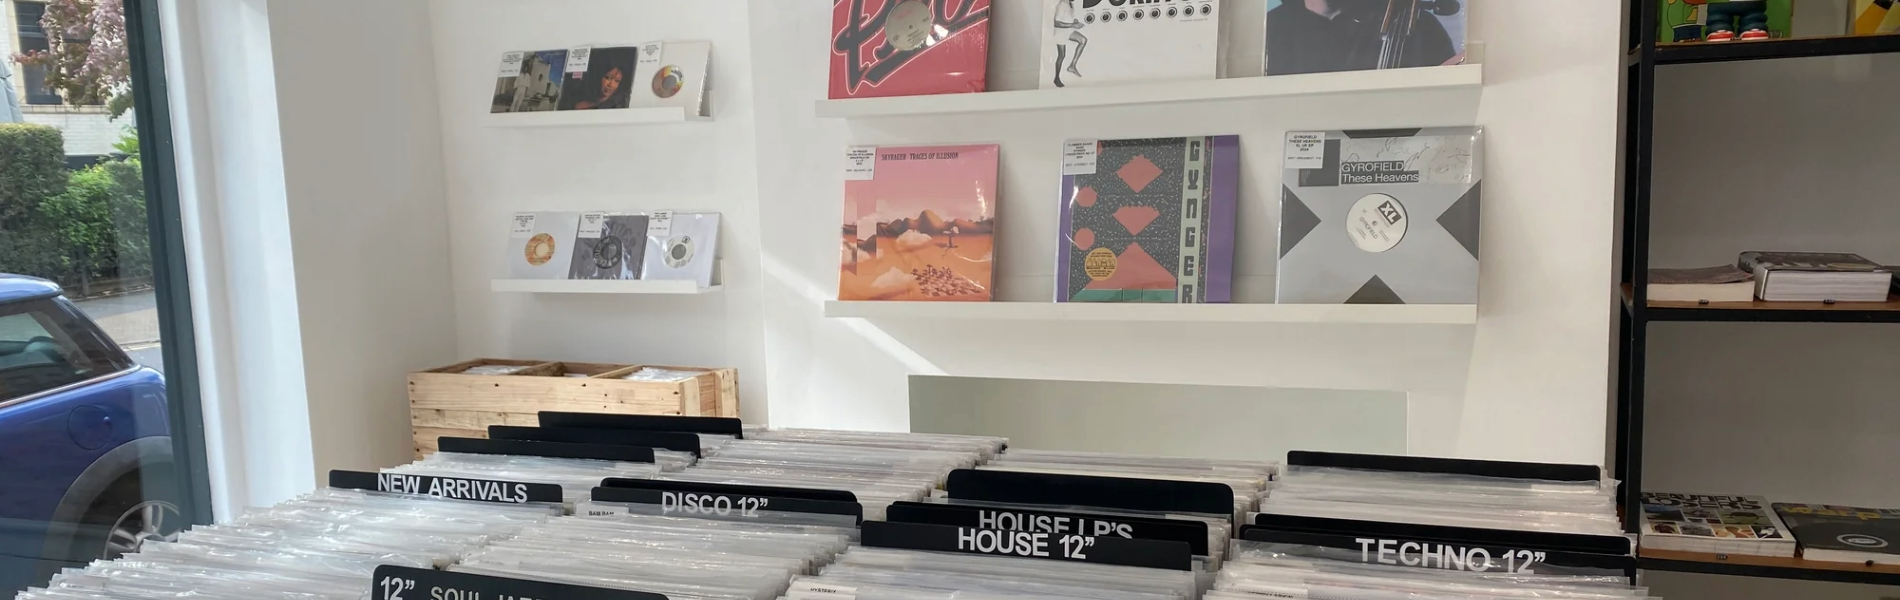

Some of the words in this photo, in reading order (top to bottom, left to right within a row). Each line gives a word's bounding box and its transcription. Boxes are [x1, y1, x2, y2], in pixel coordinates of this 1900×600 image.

[928, 152, 935, 160] OF
[1341, 162, 1404, 172] GYROFIELD
[1342, 174, 1373, 183] These
[1375, 172, 1419, 183] Heavens
[1380, 202, 1398, 223] XL
[1359, 216, 1378, 239] GYROFIELD
[377, 473, 420, 495] NEW
[428, 477, 528, 503] ARRIVALS
[662, 491, 731, 516] DISCO
[737, 497, 768, 518] 12”
[979, 510, 1071, 533] HOUSE
[958, 527, 1049, 556] HOUSE
[1059, 534, 1095, 559] 12”
[1355, 538, 1491, 572] TECHNO
[1502, 549, 1546, 574] 12”
[380, 576, 415, 600] 12”
